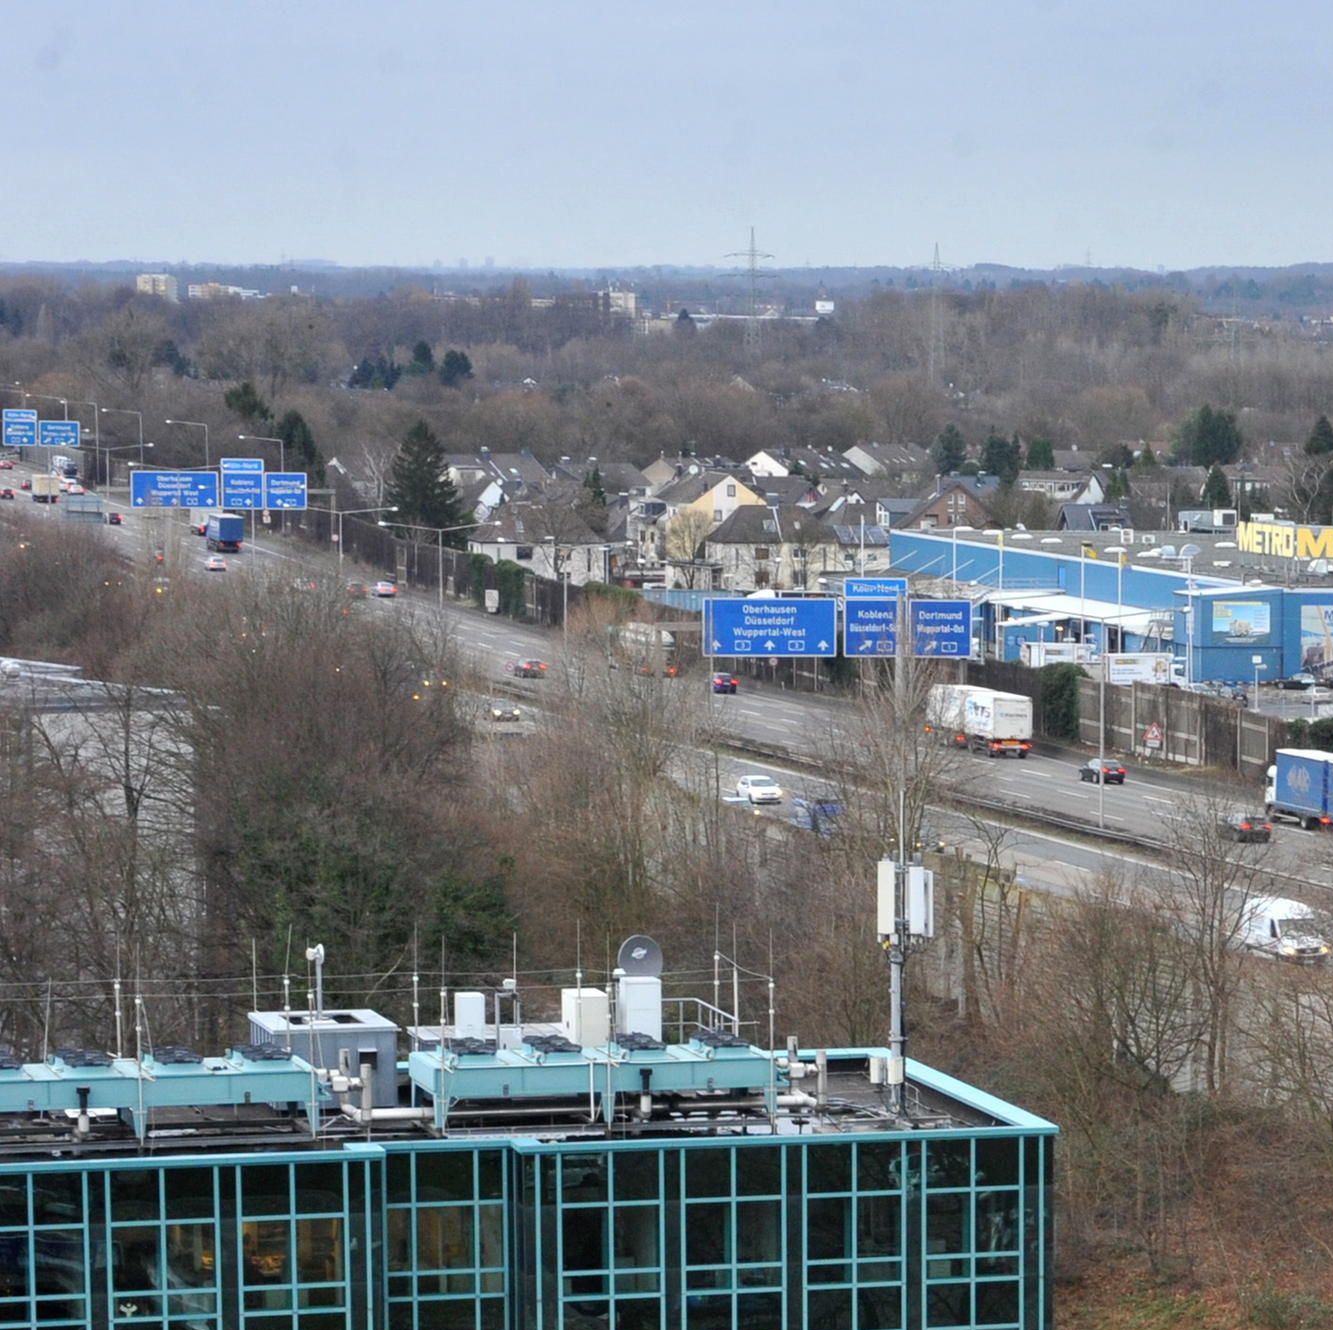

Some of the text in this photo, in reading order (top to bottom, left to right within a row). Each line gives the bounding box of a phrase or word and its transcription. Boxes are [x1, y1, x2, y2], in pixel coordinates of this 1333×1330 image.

[1238, 521, 1294, 558] METRO
[742, 604, 797, 614] Oberhausen
[858, 610, 893, 620] Koblenz
[919, 611, 962, 620] Dortmund
[744, 615, 794, 626] Düsseldorf
[733, 627, 806, 639] Wuppertal-West
